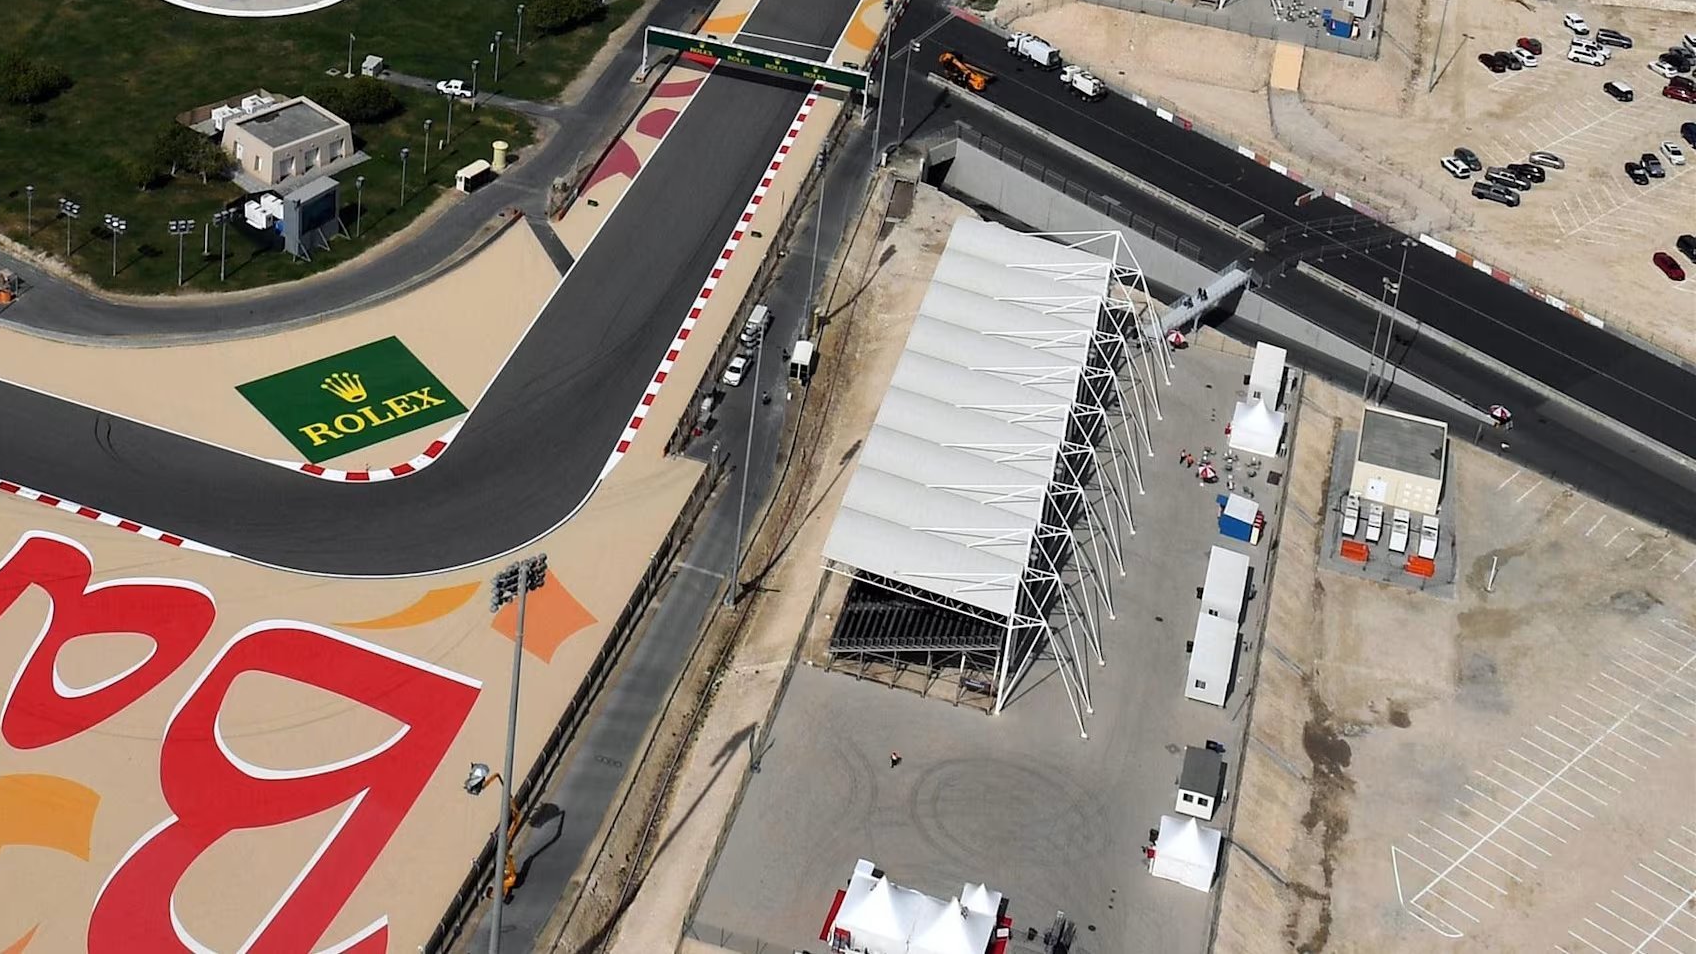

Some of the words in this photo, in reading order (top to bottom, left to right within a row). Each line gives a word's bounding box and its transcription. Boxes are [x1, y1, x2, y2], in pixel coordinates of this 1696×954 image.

[689, 47, 713, 57] ROLEX
[727, 55, 751, 65] ROLEX
[765, 63, 789, 74] ROLEX
[803, 72, 827, 81] ROLEX
[298, 387, 447, 447] ROLEX
